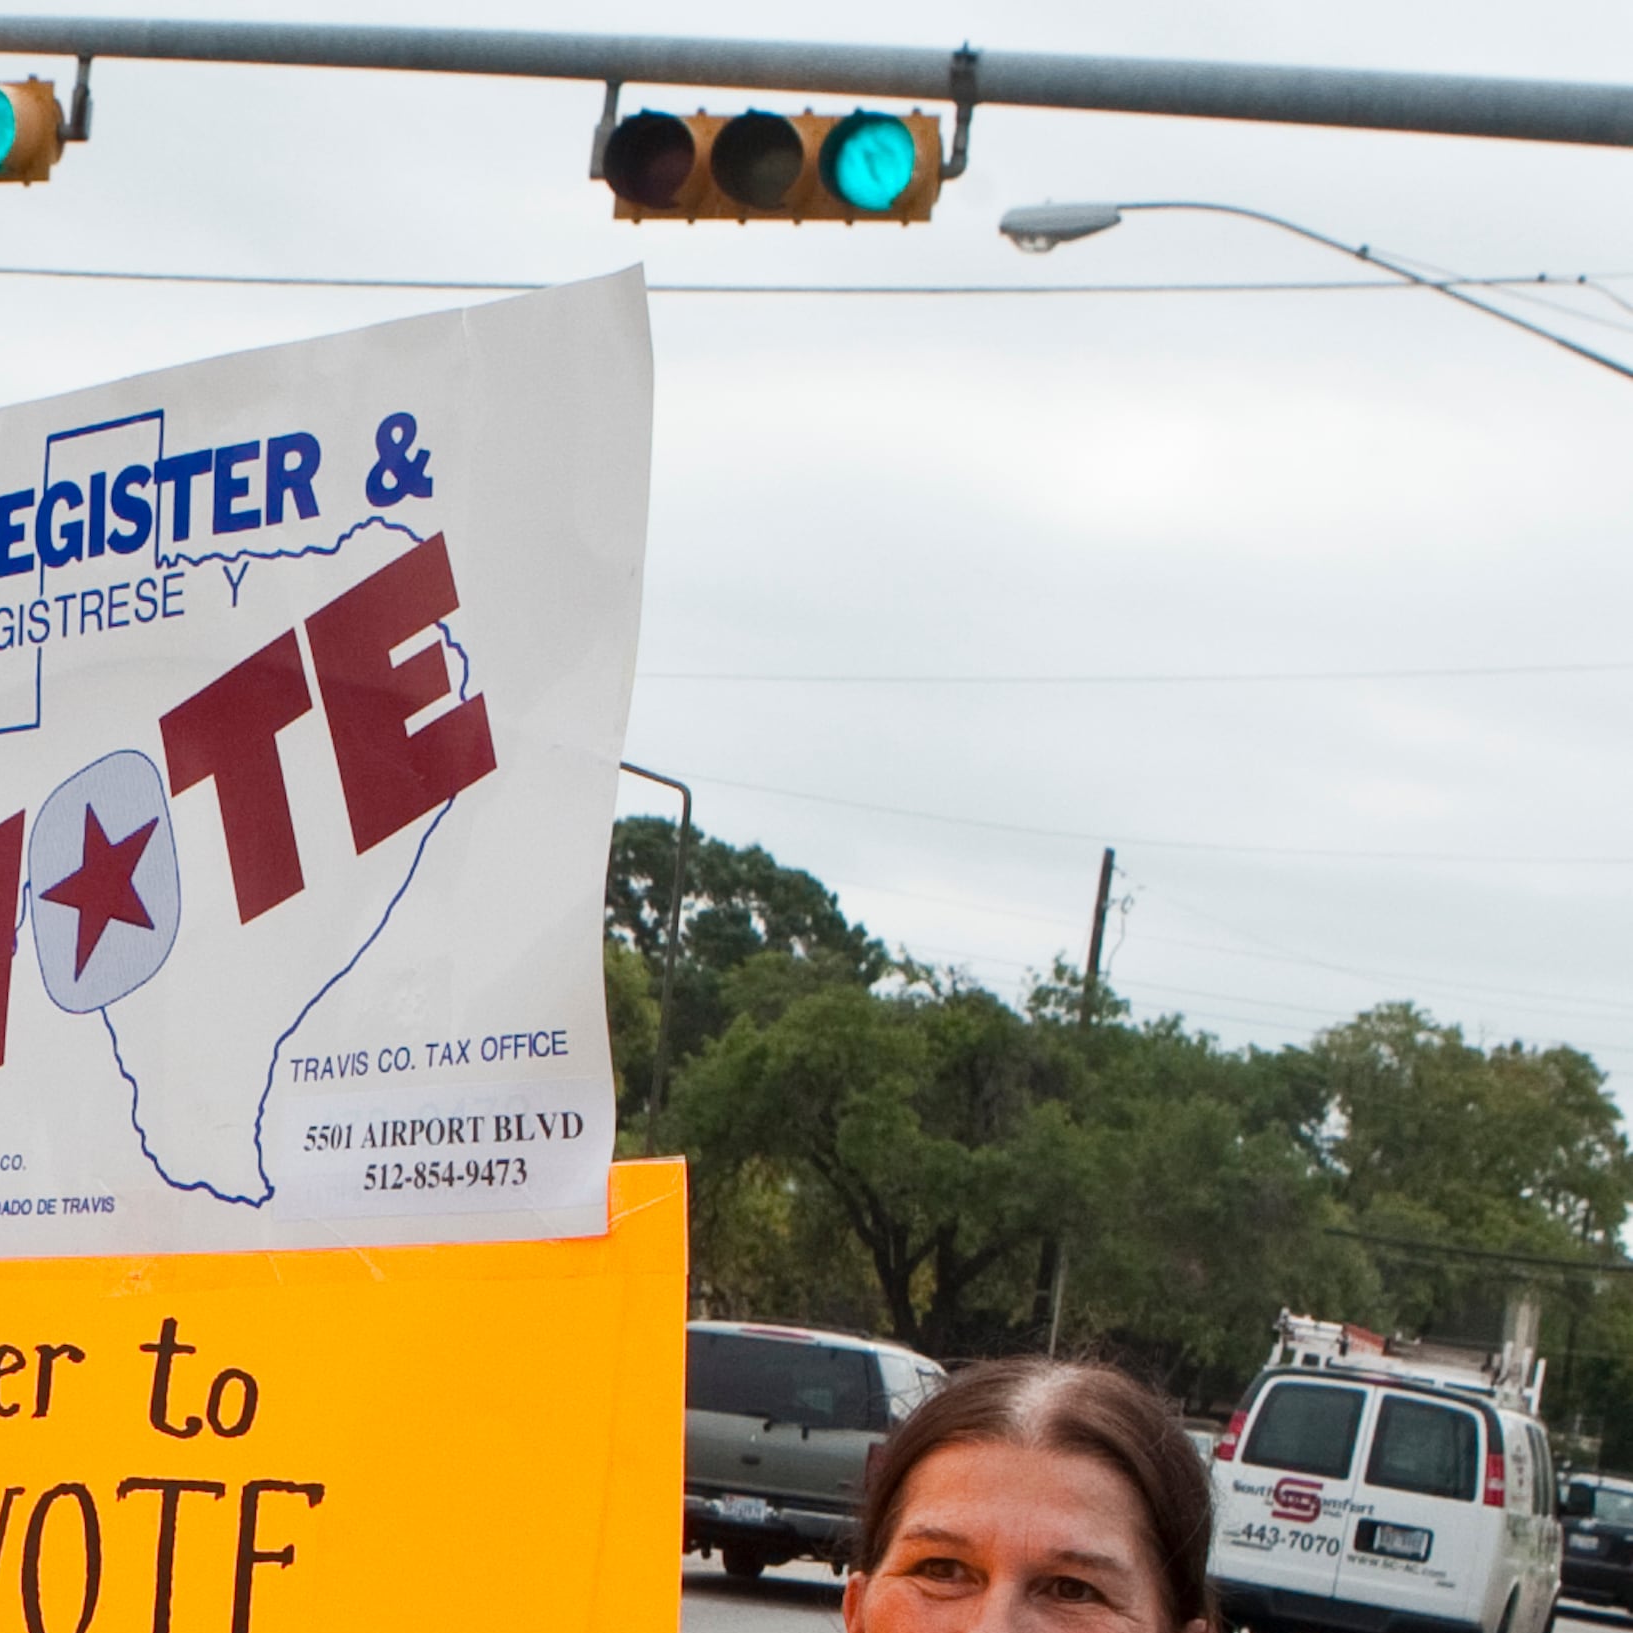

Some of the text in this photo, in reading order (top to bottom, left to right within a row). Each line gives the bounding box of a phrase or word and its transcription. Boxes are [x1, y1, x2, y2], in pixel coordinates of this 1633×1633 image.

[366, 412, 433, 507] &
[222, 561, 250, 608] Y
[290, 1029, 569, 1083] TRAVIS CO. TAX OFFICE
[302, 1110, 584, 1152] 5501 AIRPORT BLVD
[0, 1153, 26, 1171] CO.
[363, 1156, 529, 1191] 512-854-9473
[36, 1197, 57, 1216] DE
[61, 1195, 117, 1215] TRAVIS
[140, 1317, 259, 1439] to
